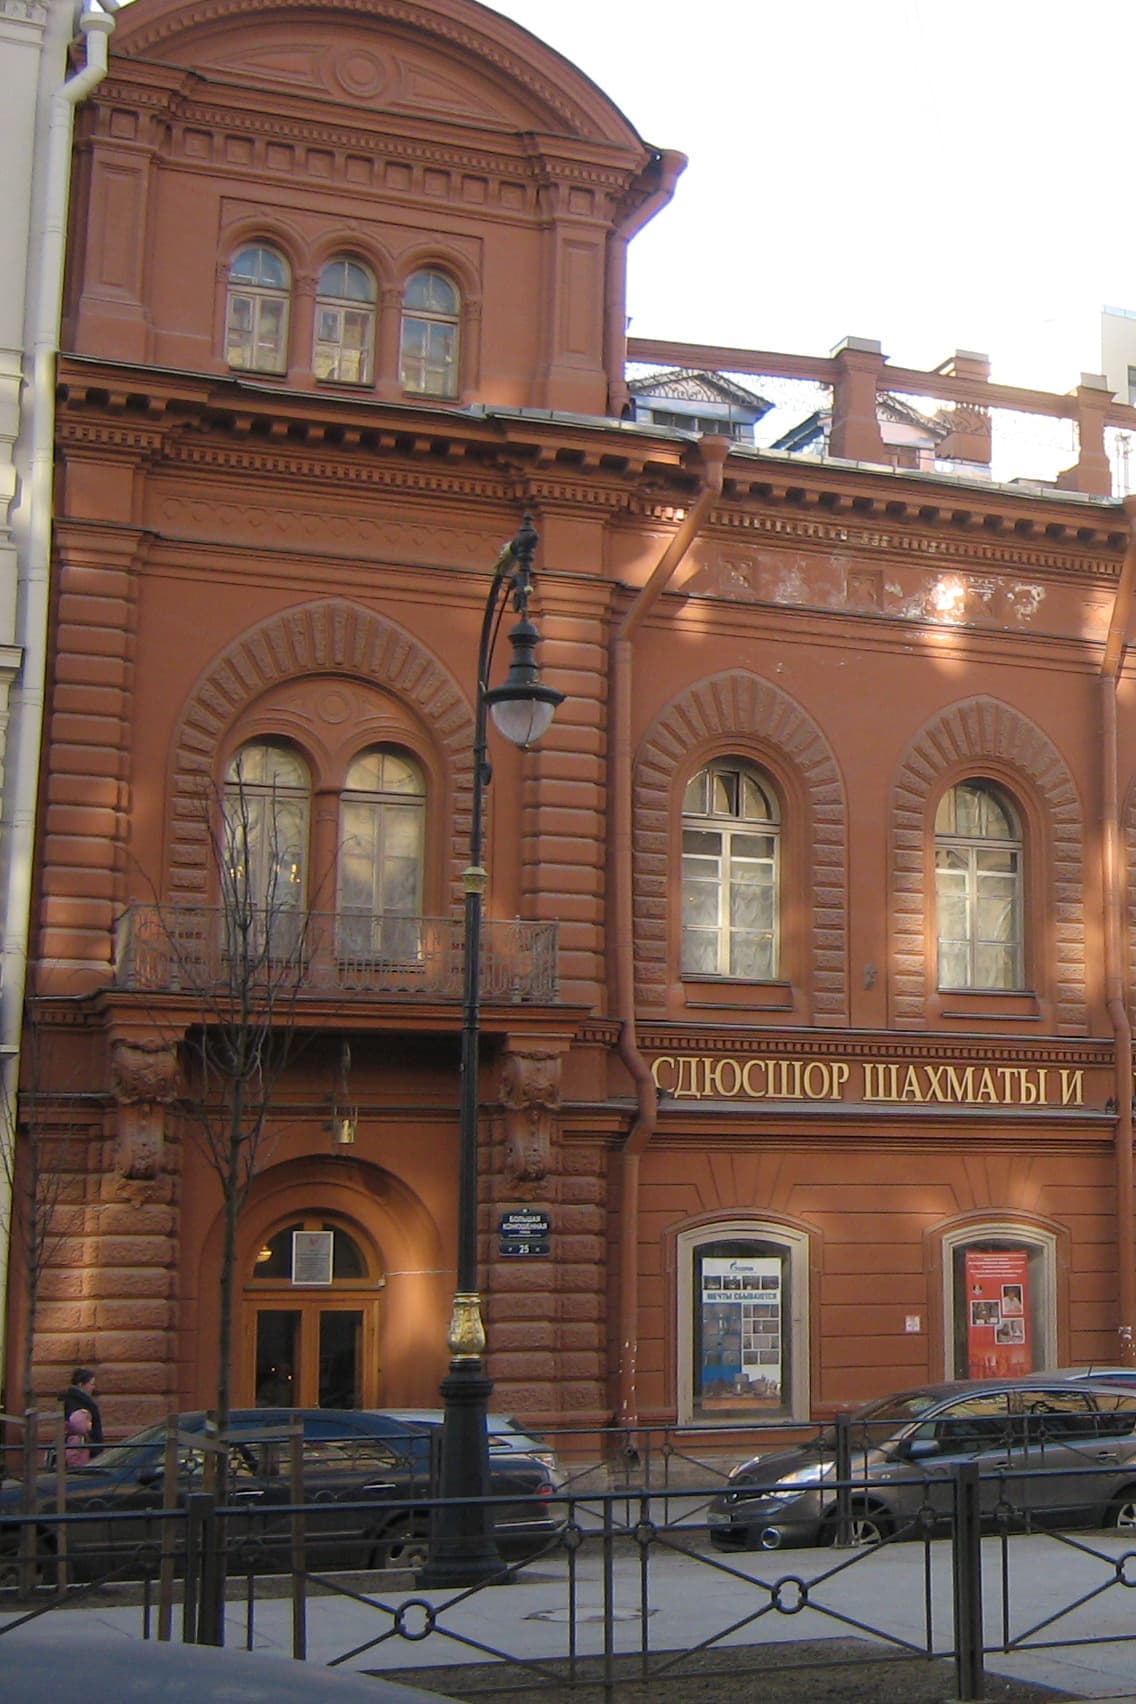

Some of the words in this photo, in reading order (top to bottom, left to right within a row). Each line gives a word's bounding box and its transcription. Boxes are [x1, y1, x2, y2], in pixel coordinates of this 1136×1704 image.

[651, 1056, 850, 1100] СДЮСШОР
[862, 1063, 1048, 1105] ШАХМАТЫ
[1059, 1069, 1085, 1105] И
